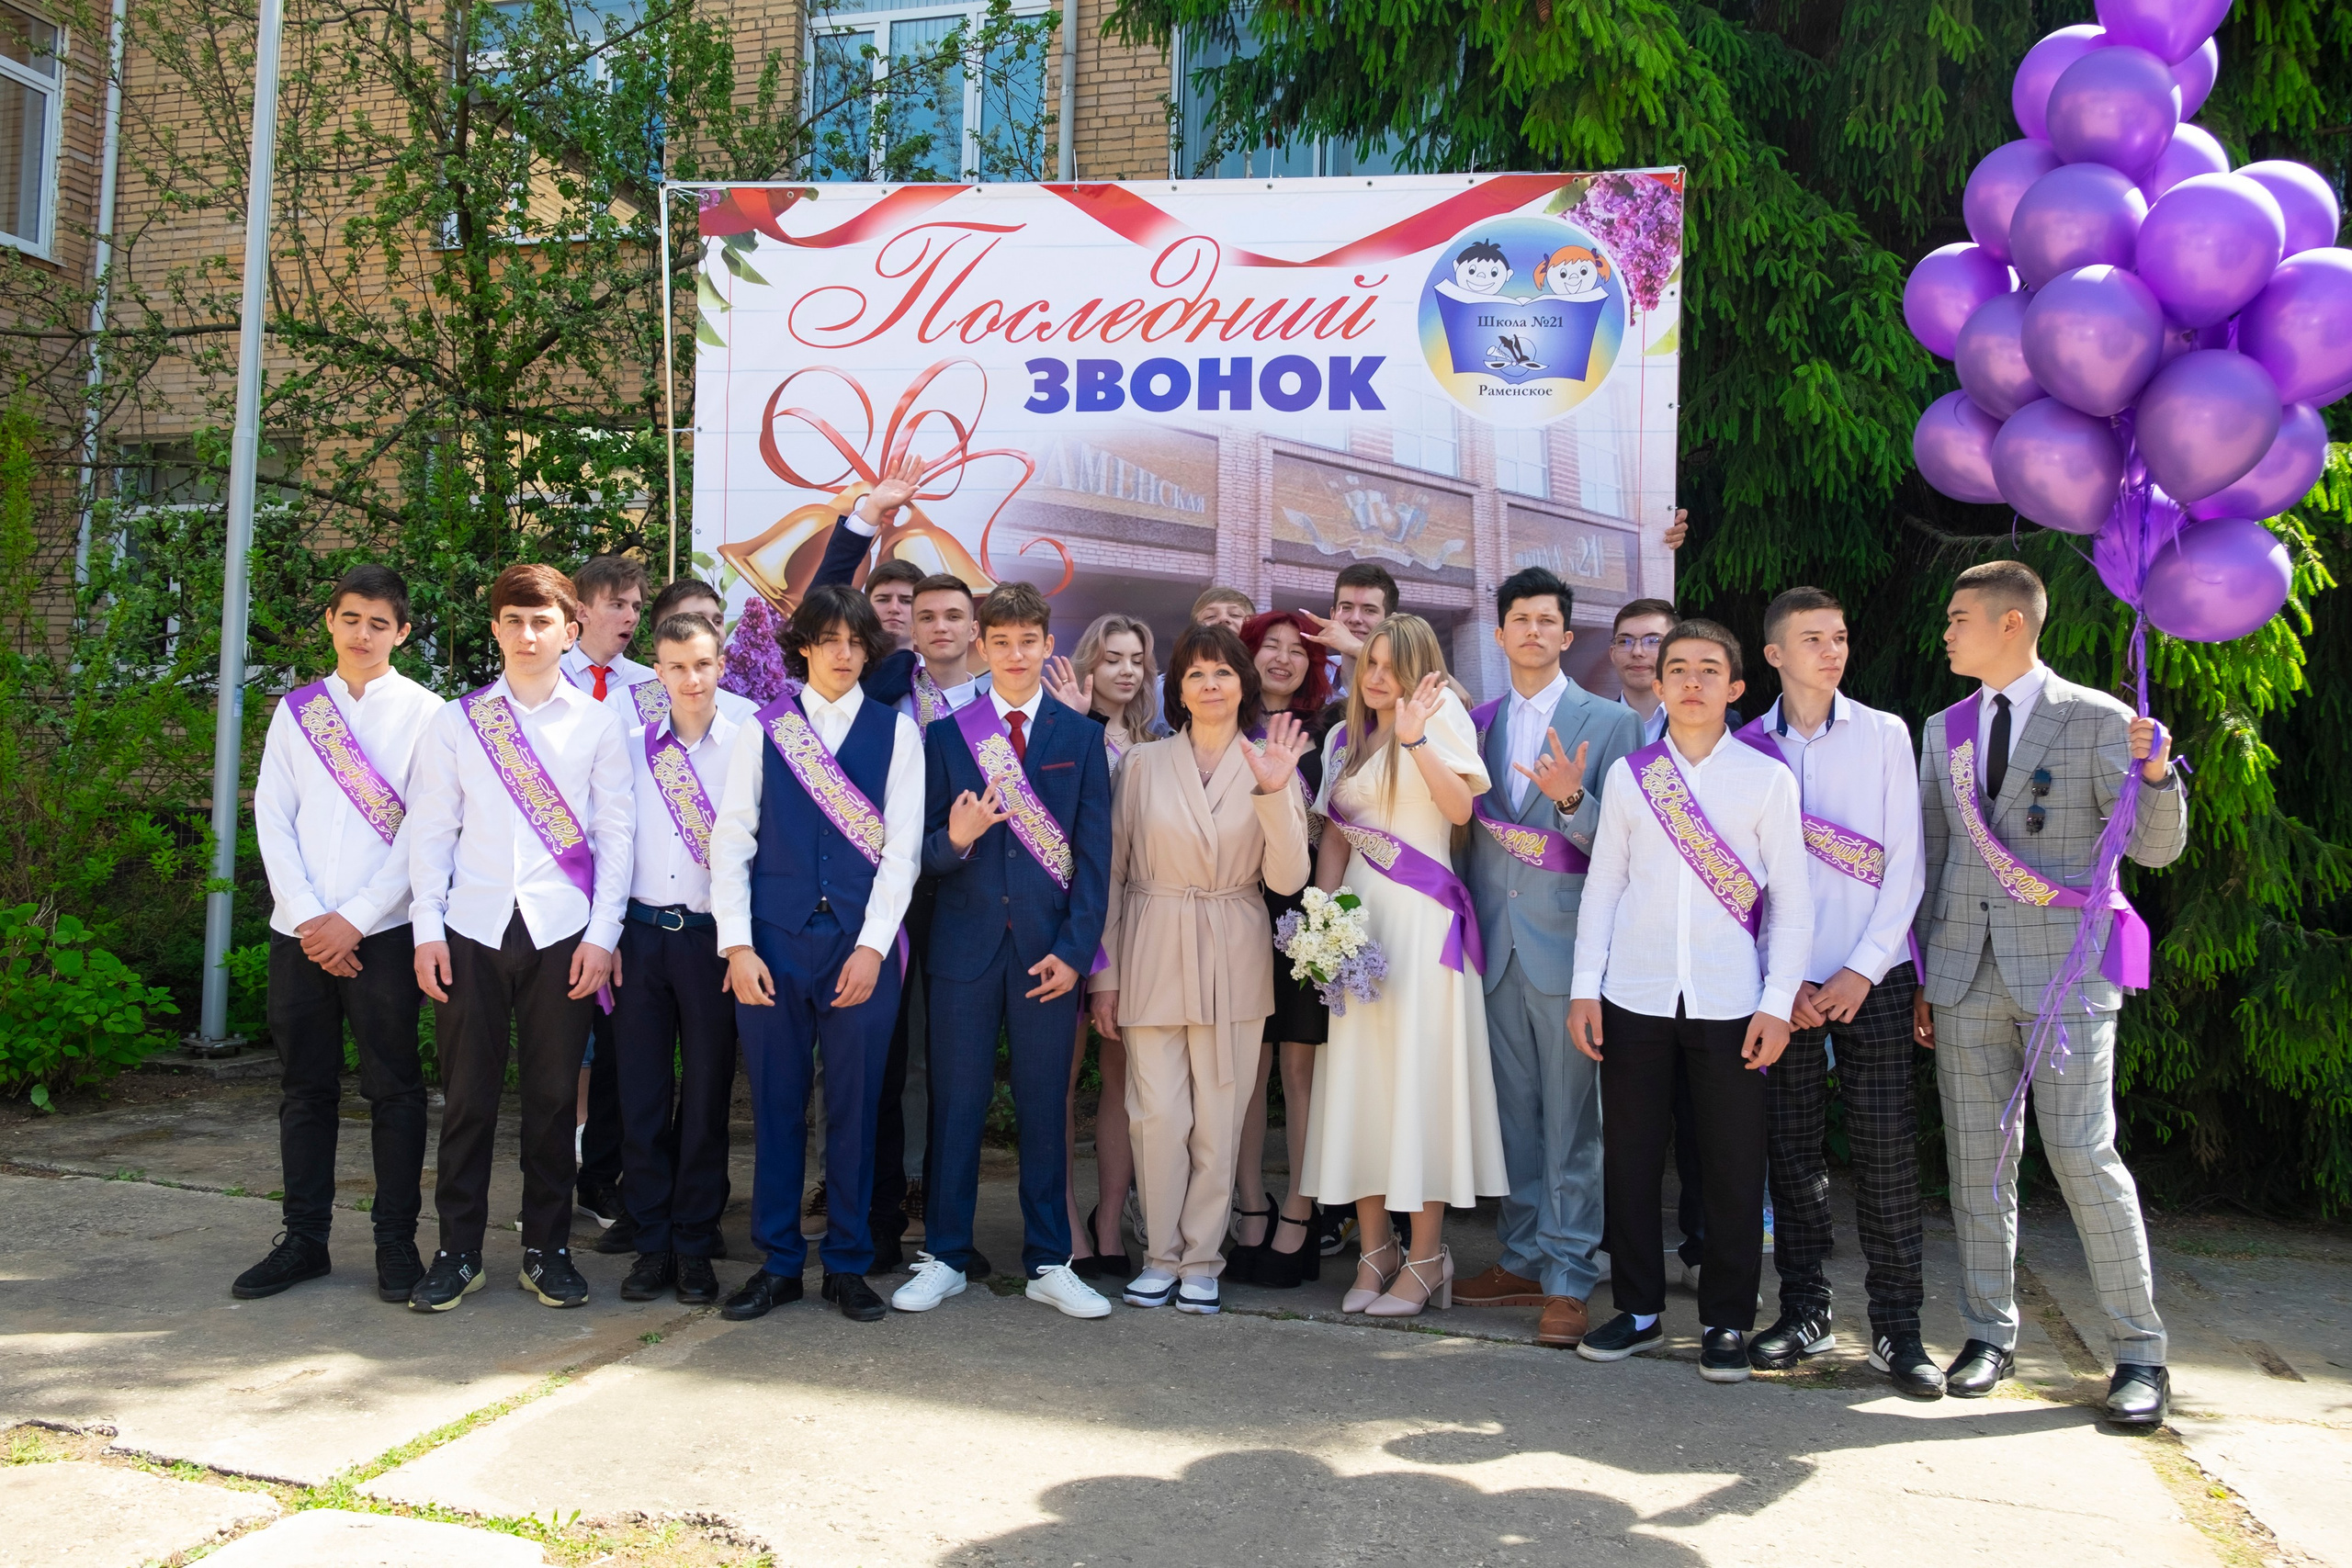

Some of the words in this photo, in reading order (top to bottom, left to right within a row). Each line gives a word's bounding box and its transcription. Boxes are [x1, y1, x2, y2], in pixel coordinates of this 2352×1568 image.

[788, 220, 1388, 347] Последний
[1477, 316, 1527, 328] Школа
[1531, 316, 1564, 328] №21
[1023, 355, 1387, 413] ЗВОНОК
[1478, 384, 1553, 397] Раменское
[1034, 434, 1205, 513] АМЕНСКАЯ
[317, 712, 393, 825] Выпускник
[484, 705, 560, 826] Выпускник
[540, 806, 583, 849] 2024
[791, 732, 871, 840] Выпускник
[1365, 834, 1401, 870] 2024
[1503, 829, 1548, 857] 2024
[1657, 776, 1739, 896] Выпускник
[1721, 872, 1758, 912] 2024
[2005, 867, 2059, 907] 2024
